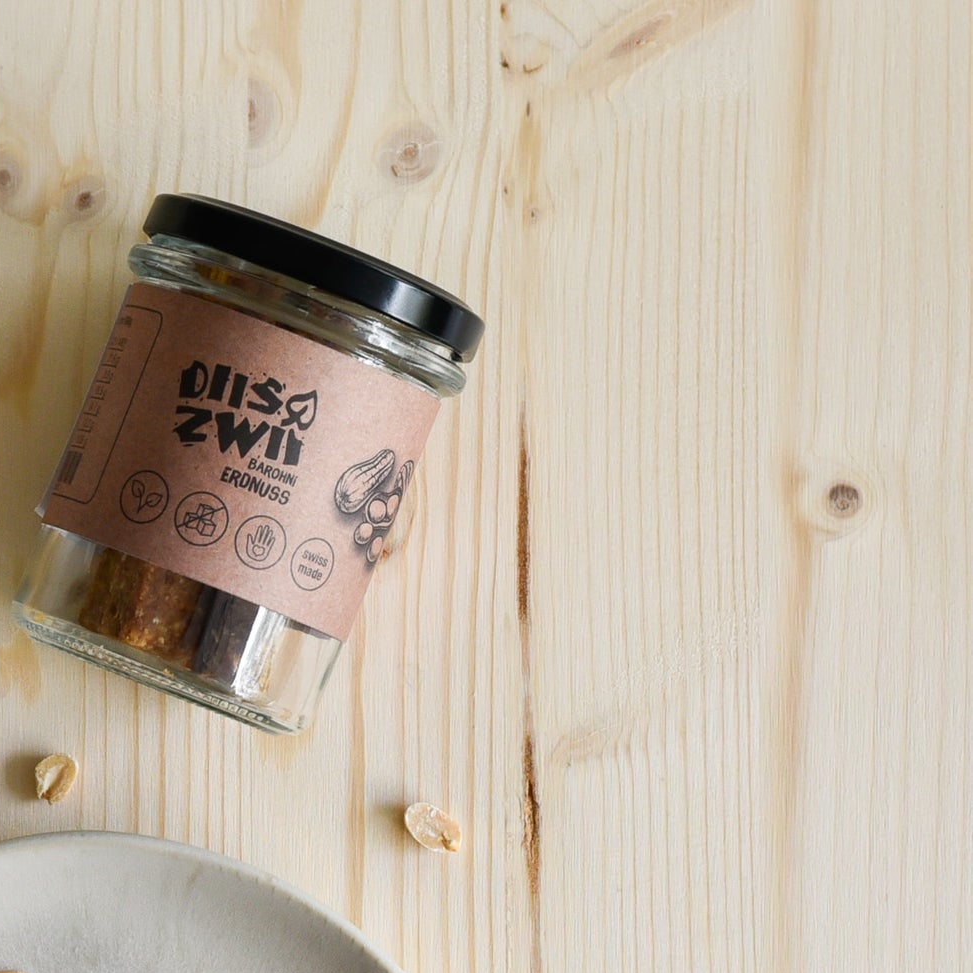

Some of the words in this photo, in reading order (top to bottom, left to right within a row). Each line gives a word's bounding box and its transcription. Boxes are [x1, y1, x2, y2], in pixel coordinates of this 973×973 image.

[179, 360, 284, 415] DIIS
[220, 465, 291, 505] ERDNUSS
[297, 564, 323, 581] made
[302, 550, 329, 567] swiss
